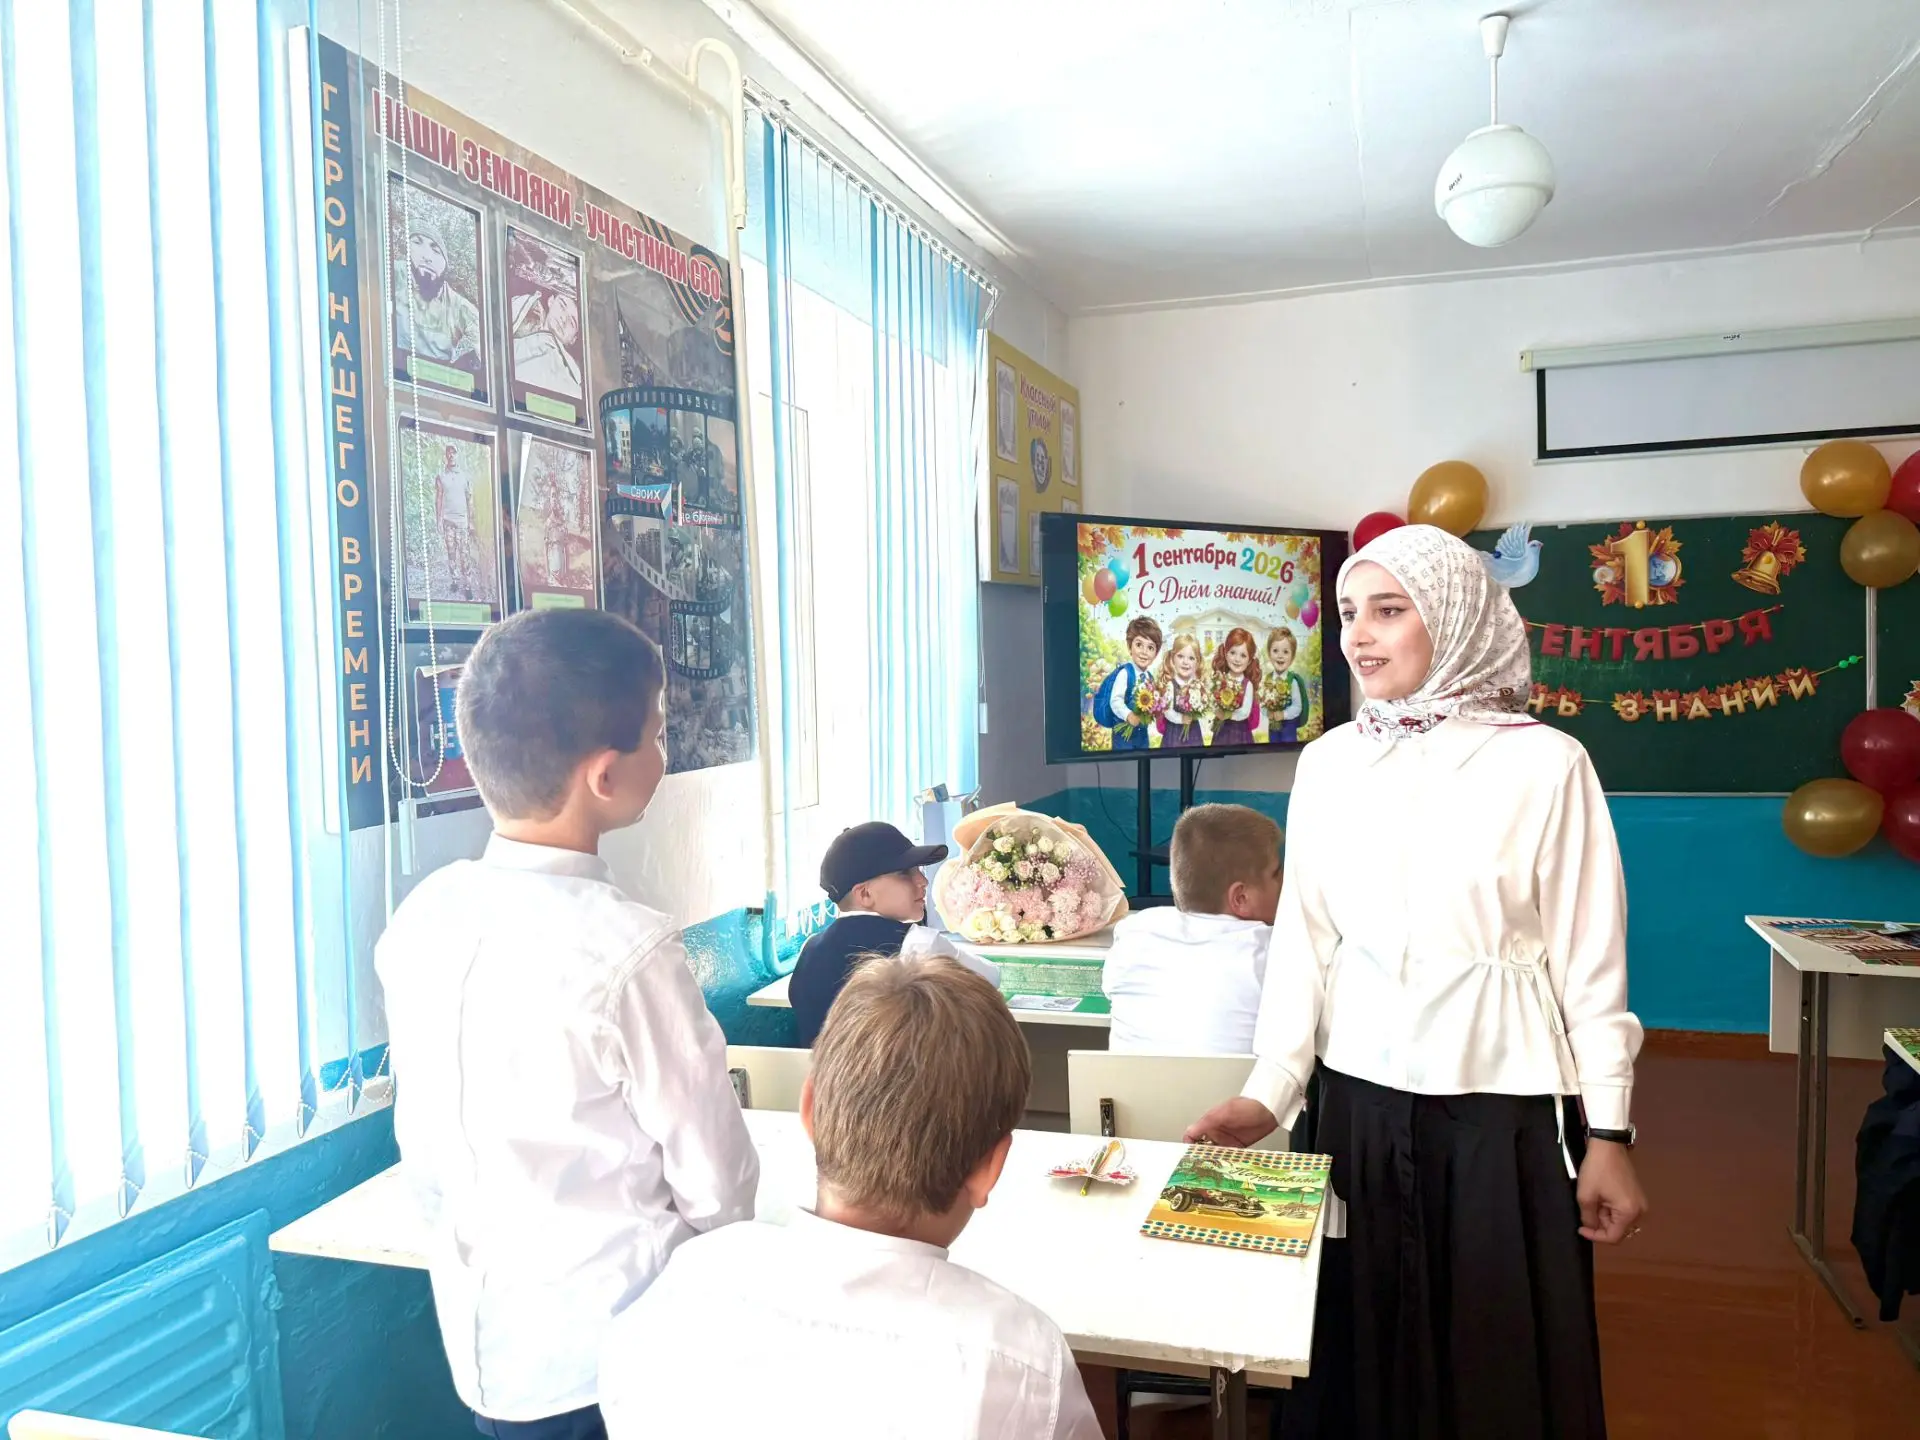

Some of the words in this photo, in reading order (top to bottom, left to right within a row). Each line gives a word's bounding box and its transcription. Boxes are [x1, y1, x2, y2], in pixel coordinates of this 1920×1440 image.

[322, 82, 347, 266] ГЕРОИ
[372, 87, 459, 175] НАШИ
[462, 137, 573, 230] ЗЕМЛЯКИ
[585, 200, 689, 287] УЧАСТНИКИ
[690, 255, 722, 302] СВО
[329, 292, 359, 508] НАШЕГО
[630, 486, 661, 500] Своих
[1132, 542, 1149, 579] 1
[1239, 547, 1295, 584] 2026
[1138, 579, 1155, 610] С
[1159, 576, 1211, 605] Днём
[1213, 583, 1282, 607] знаний!
[1611, 529, 1648, 606] 1
[341, 536, 372, 784] ВРЕМЕНИ
[1522, 610, 1773, 661] ЕНТЯБРЯ
[1524, 690, 1579, 718] НЬ
[1618, 668, 1817, 721] ЗНАНИЙ
